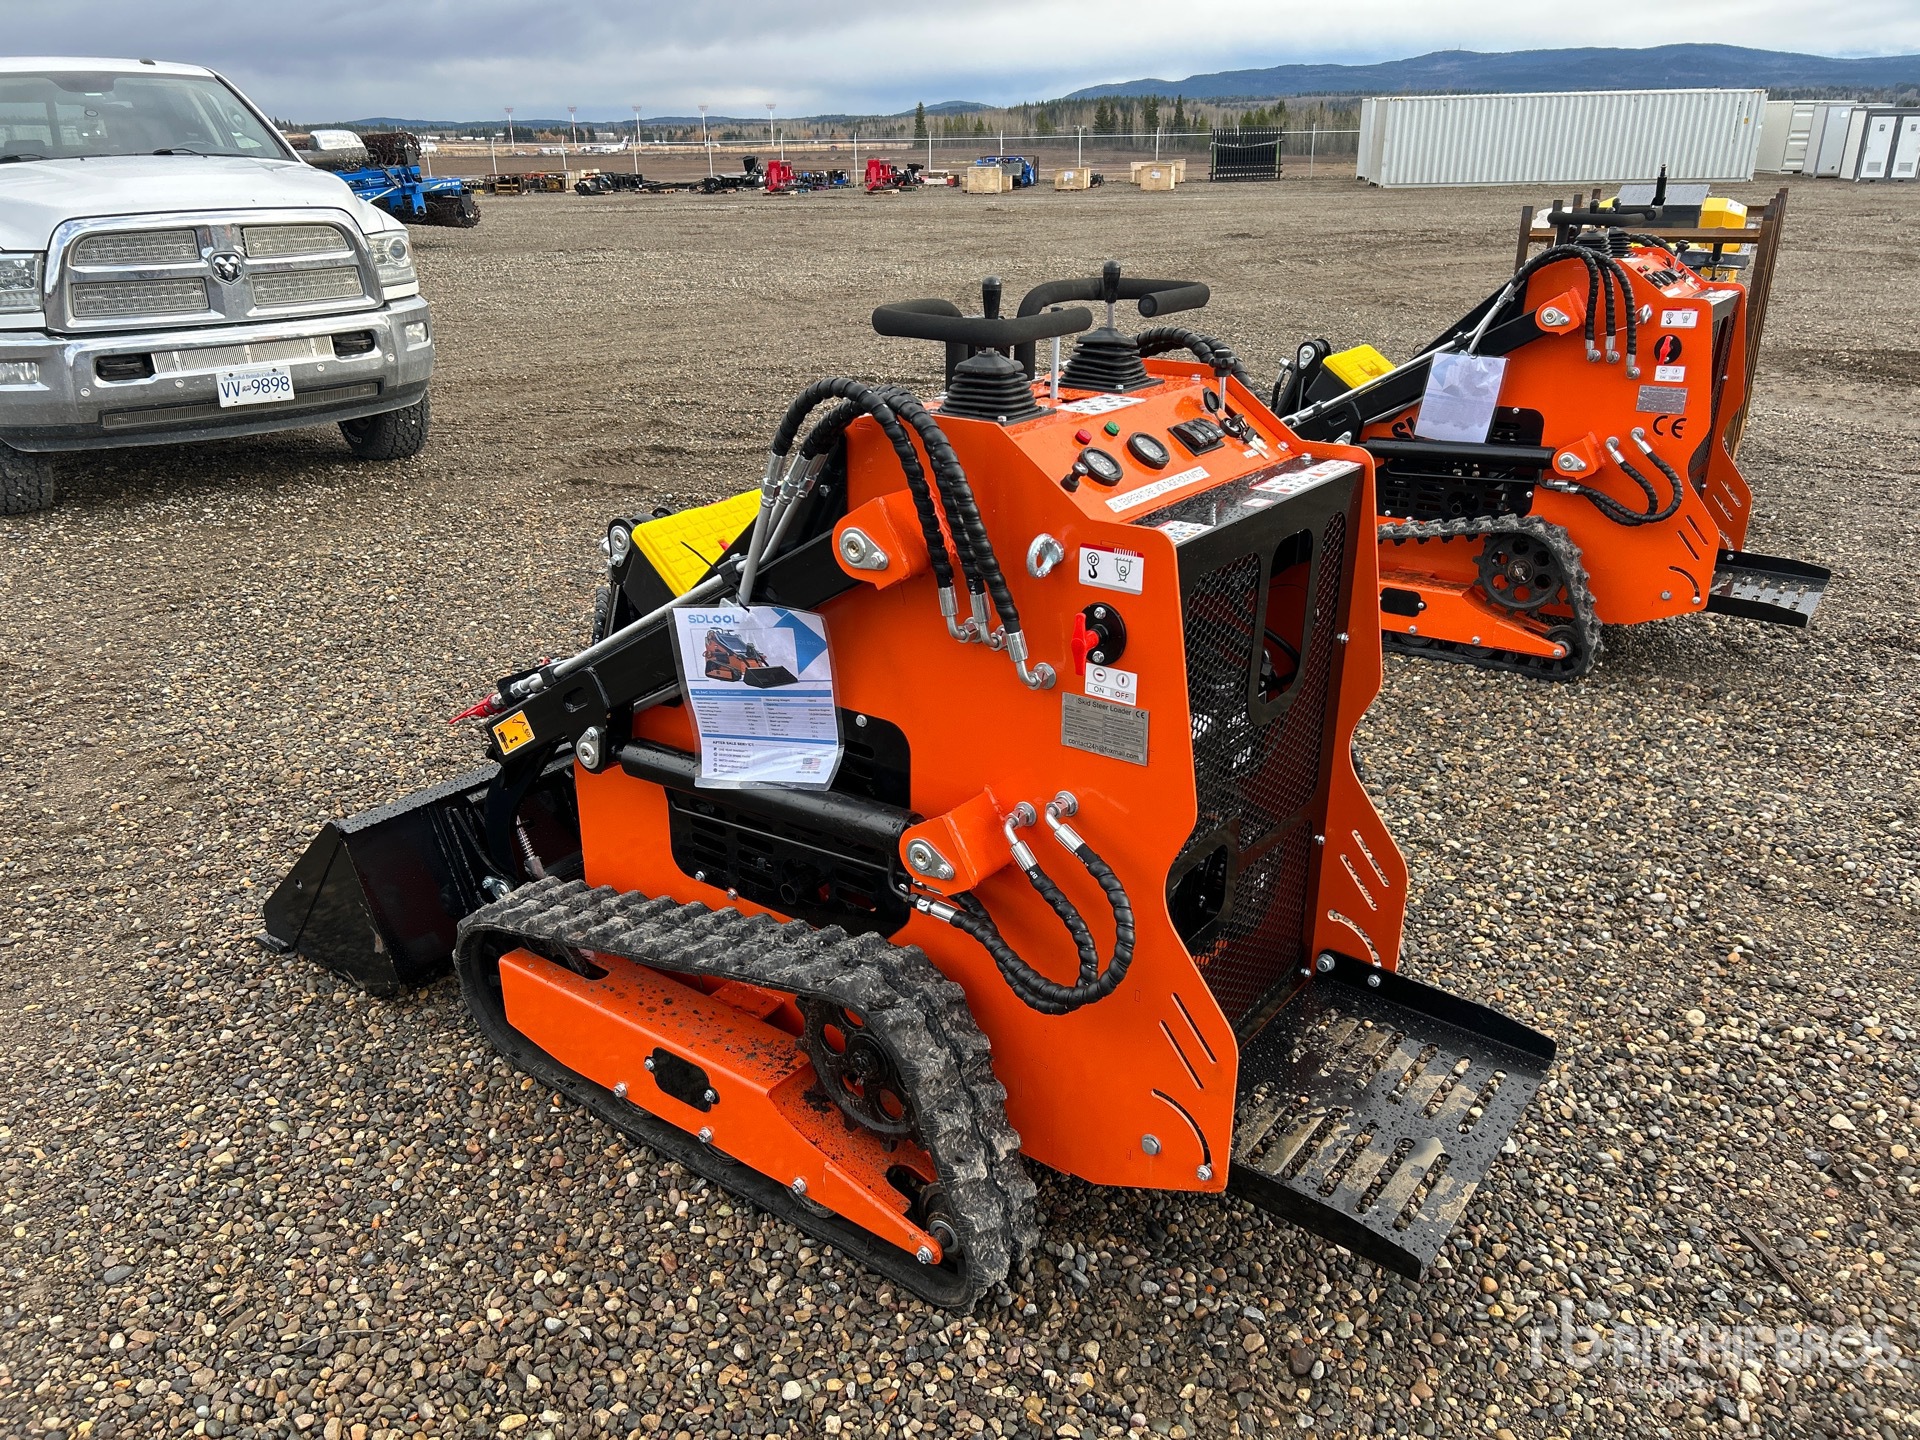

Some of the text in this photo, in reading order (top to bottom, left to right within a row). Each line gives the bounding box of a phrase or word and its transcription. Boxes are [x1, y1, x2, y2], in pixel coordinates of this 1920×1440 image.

[220, 375, 290, 399] VV 9898
[687, 614, 740, 624] SDLOOL
[1093, 685, 1129, 700] ON OFF
[1077, 697, 1091, 708] Skid
[1091, 701, 1110, 712] Steer
[1109, 705, 1132, 717] Loader
